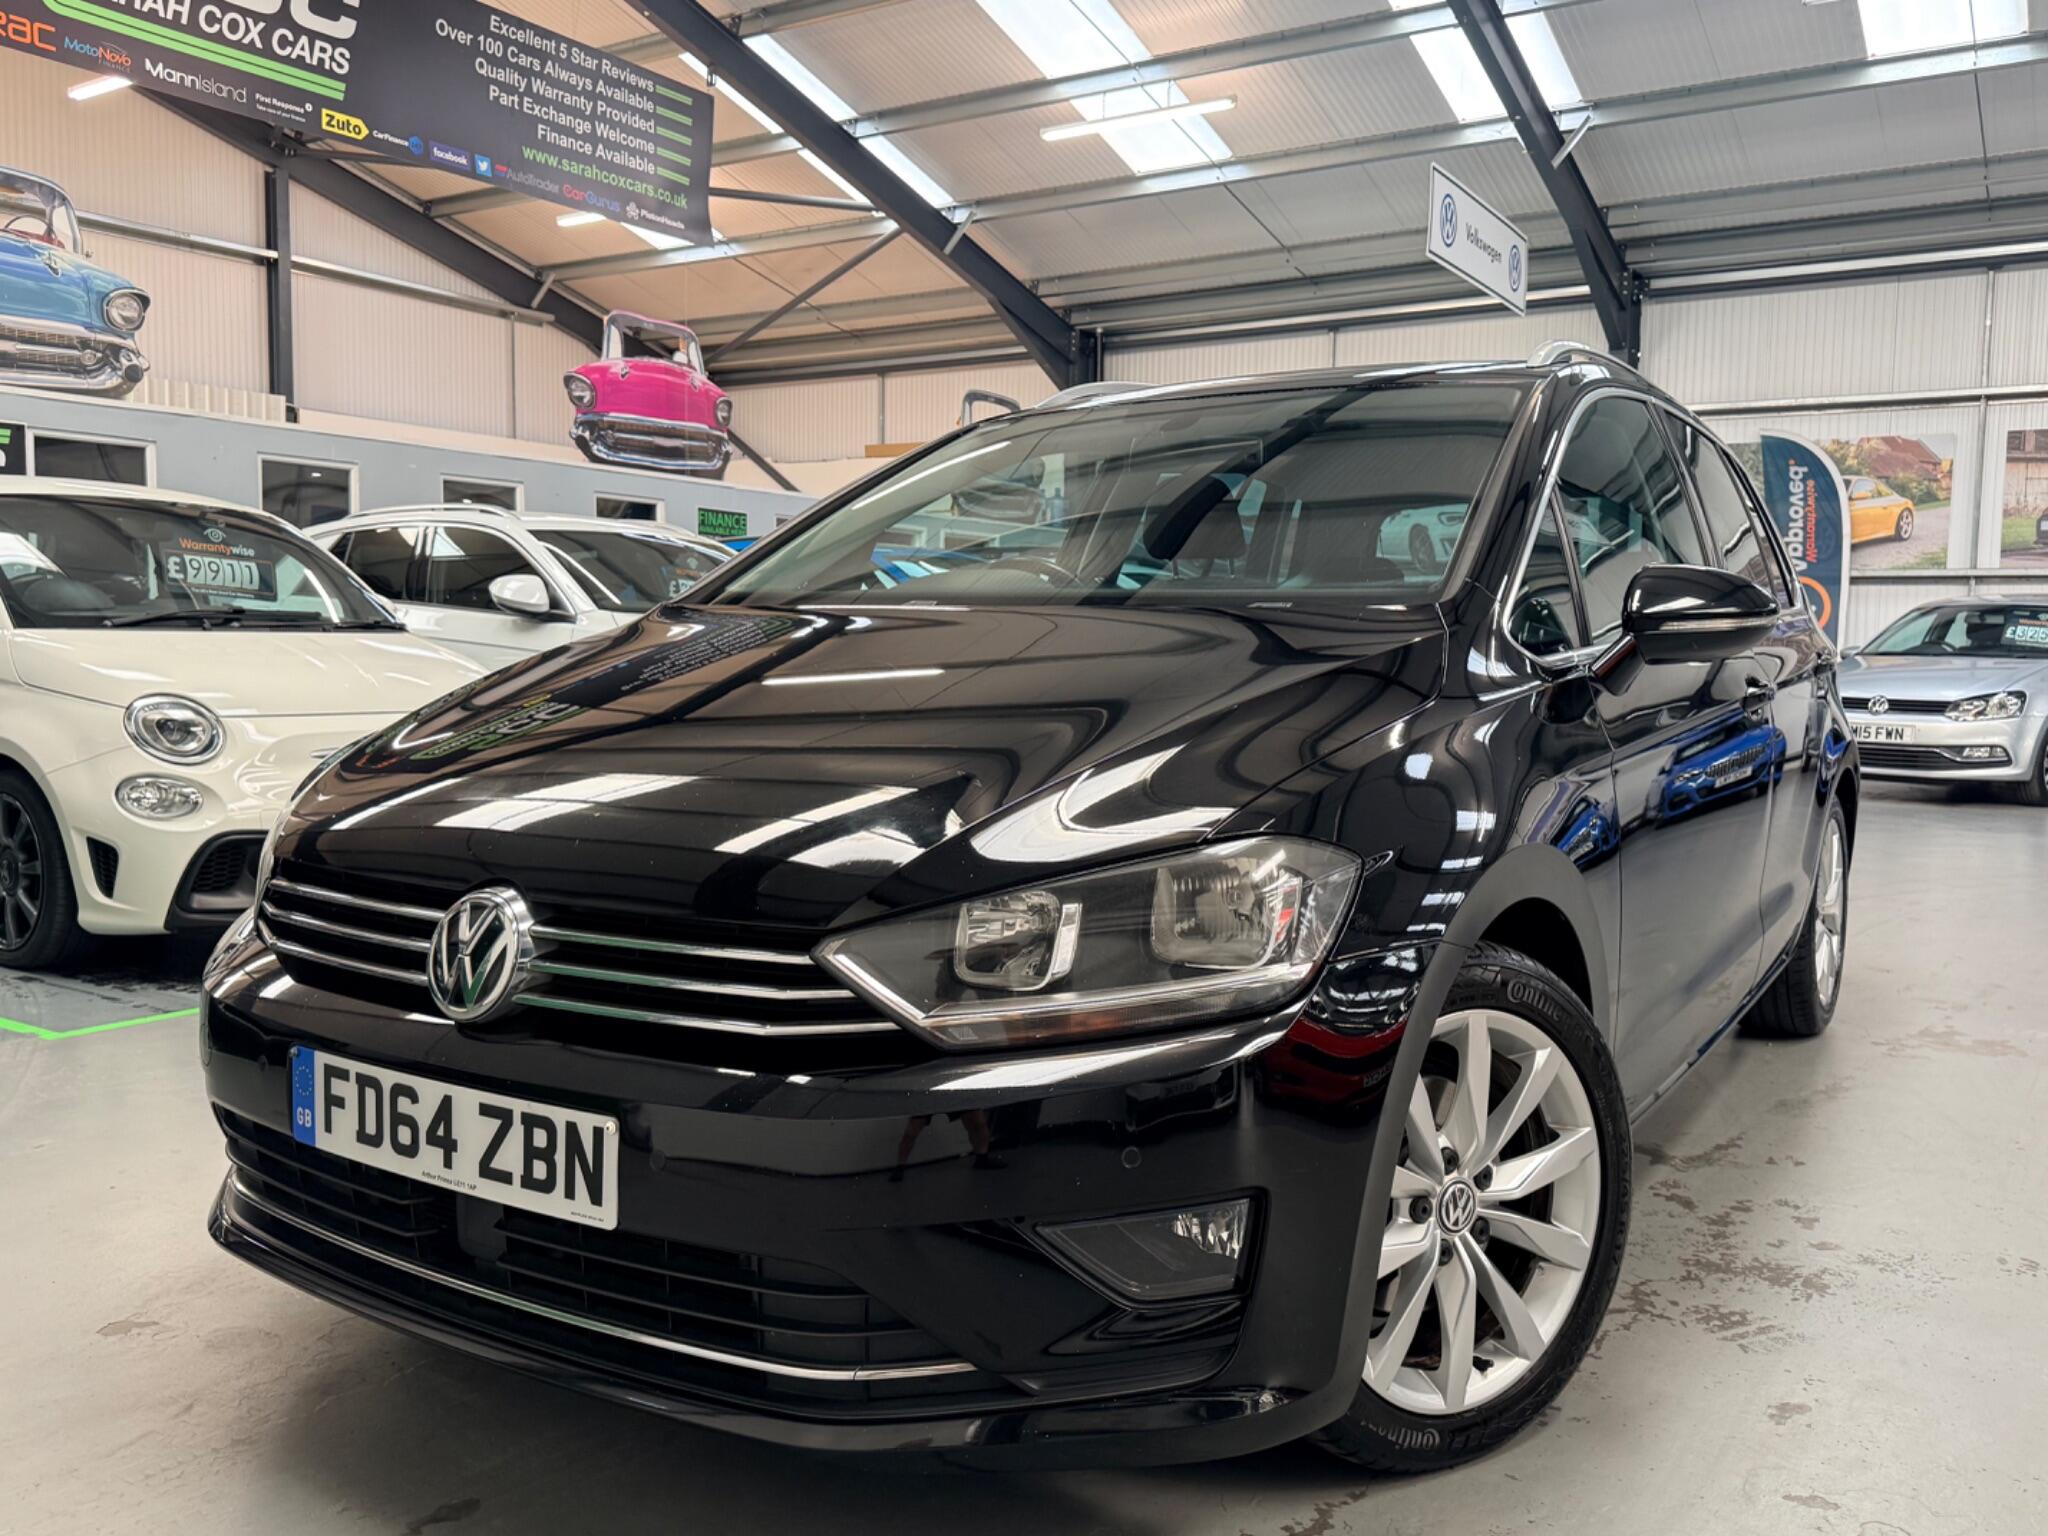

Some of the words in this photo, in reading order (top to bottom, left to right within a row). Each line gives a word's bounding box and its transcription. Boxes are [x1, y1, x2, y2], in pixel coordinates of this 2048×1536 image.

[199, 4, 264, 49] COX
[271, 27, 351, 75] CARS
[489, 14, 556, 55] Excellent
[559, 44, 567, 59] 5
[571, 47, 599, 71] Star
[601, 57, 654, 93] Reviews
[435, 18, 473, 47] Over
[477, 35, 503, 58] 100
[507, 45, 541, 72] Cars
[543, 60, 593, 91] Always
[596, 79, 654, 113] Available
[475, 57, 527, 90] Quality
[531, 77, 593, 113] Warranty
[597, 102, 654, 134] Provided
[325, 112, 362, 136] Zuto
[488, 85, 519, 110] Part
[523, 99, 592, 134] Exchange
[594, 122, 655, 154] Welcome
[433, 146, 469, 166] facebook
[537, 124, 593, 154] Finance
[595, 144, 654, 175] Available
[521, 144, 688, 209] www.sarahcoxcars.co.uk
[562, 183, 621, 213] CarGurus
[1465, 222, 1502, 264] Volkswagen
[699, 511, 747, 529] FINANCE
[179, 537, 255, 557] Warrantywise
[1875, 726, 1904, 741] FWN
[296, 1106, 312, 1129] GB
[323, 1062, 458, 1170] FD64
[478, 1102, 605, 1208] ZBN
